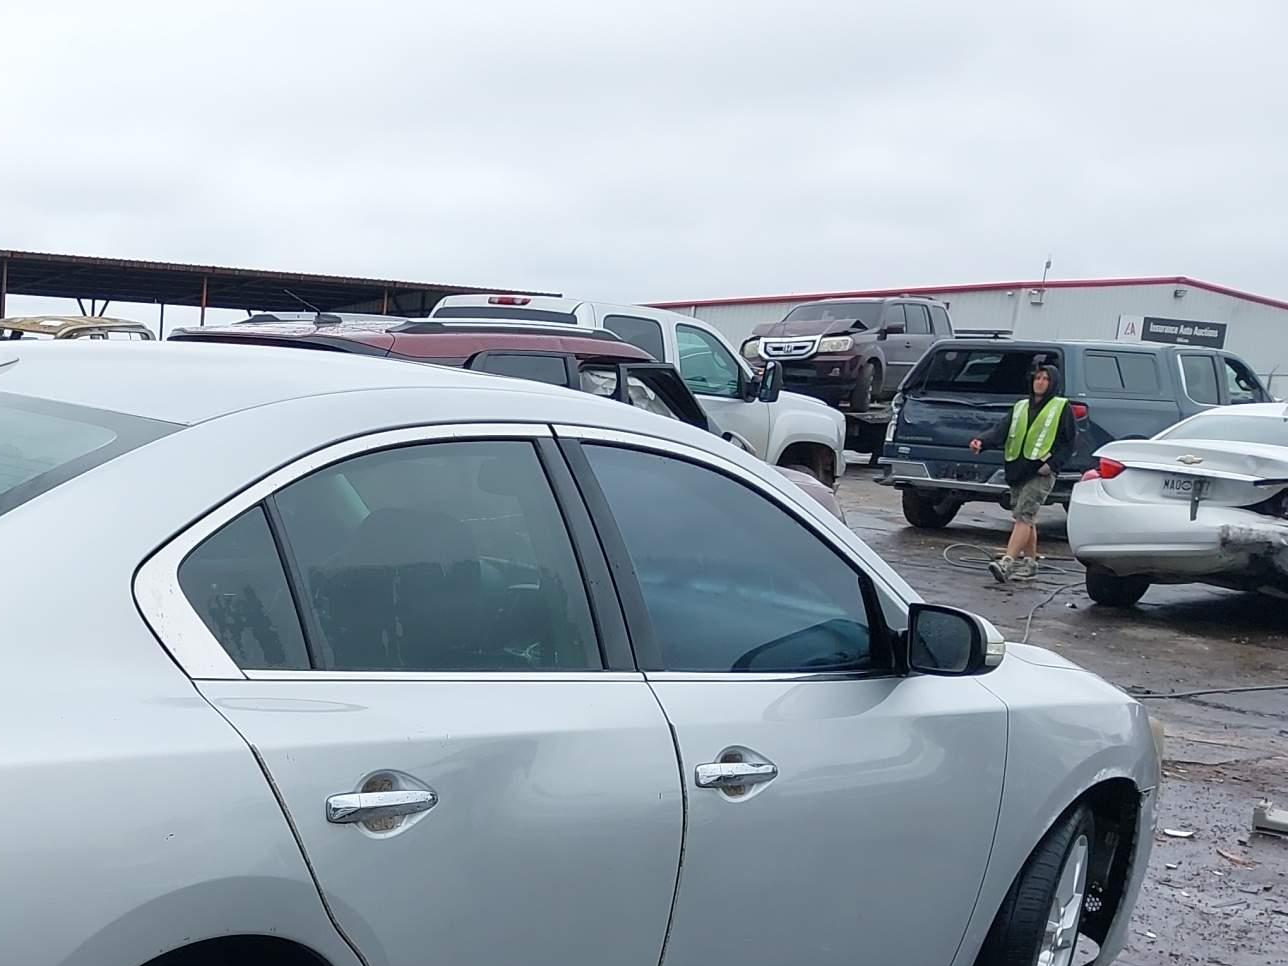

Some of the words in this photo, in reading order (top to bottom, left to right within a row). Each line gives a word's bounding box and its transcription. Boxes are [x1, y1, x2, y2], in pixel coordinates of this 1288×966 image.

[1149, 322, 1179, 334] Insurance
[1179, 324, 1193, 335] Auto
[1193, 326, 1219, 338] Auctions
